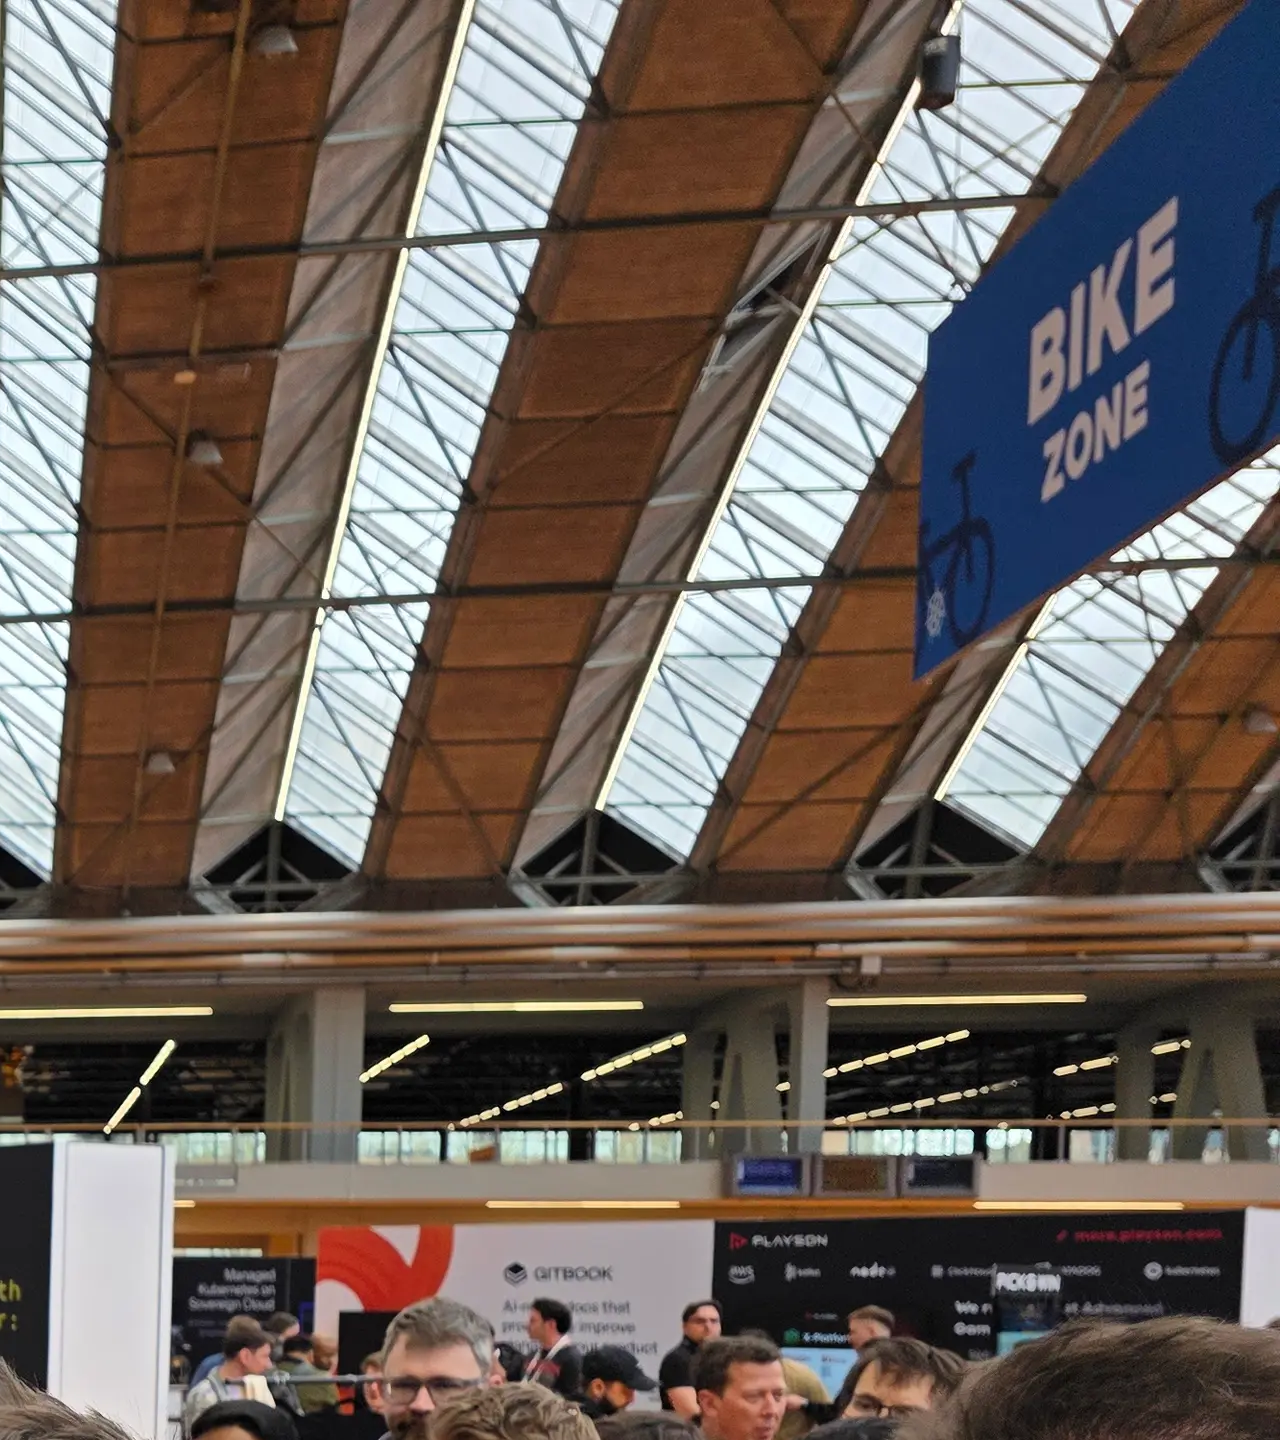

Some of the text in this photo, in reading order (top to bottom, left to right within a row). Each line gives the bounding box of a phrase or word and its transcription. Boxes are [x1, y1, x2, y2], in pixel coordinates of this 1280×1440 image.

[1027, 195, 1178, 425] BIKE
[1040, 358, 1150, 502] ZONE
[752, 1234, 828, 1248] PLAYSON
[224, 1267, 276, 1282] Managed
[534, 1265, 613, 1282] GITBOOK
[197, 1282, 259, 1297] Kubernetes
[242, 1296, 275, 1312] Cloud
[602, 1299, 630, 1314] that
[579, 1320, 636, 1334] improve
